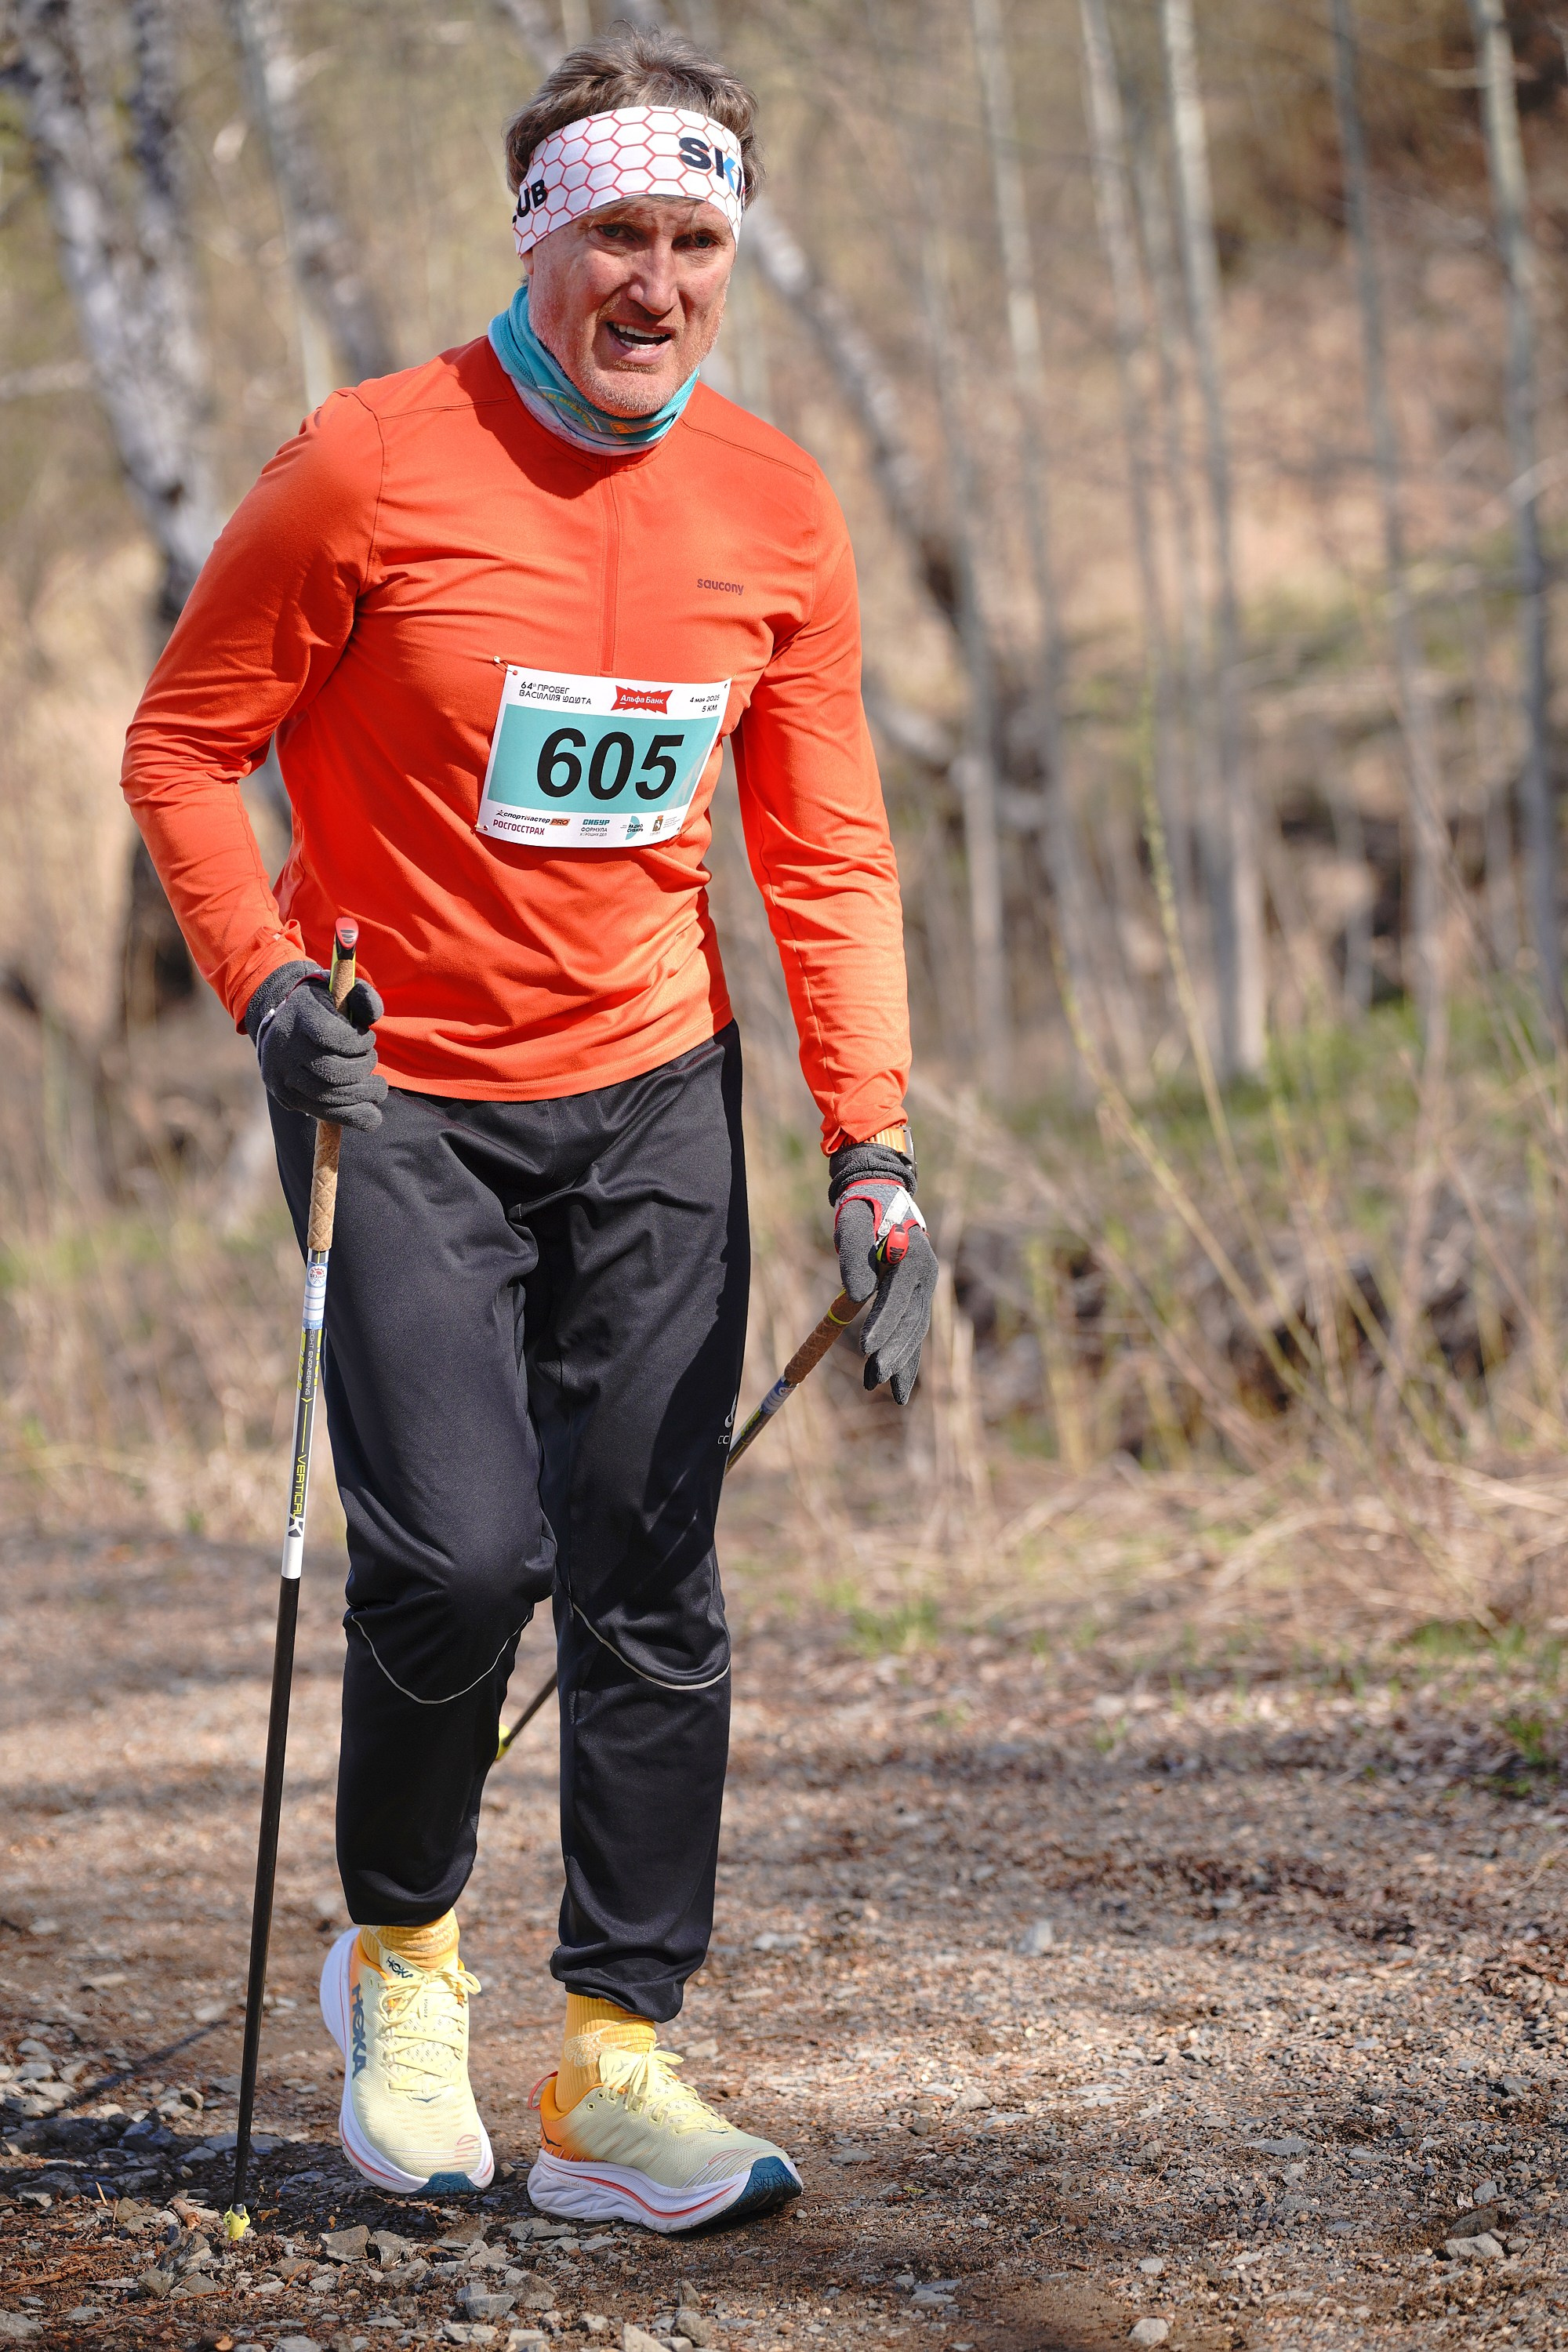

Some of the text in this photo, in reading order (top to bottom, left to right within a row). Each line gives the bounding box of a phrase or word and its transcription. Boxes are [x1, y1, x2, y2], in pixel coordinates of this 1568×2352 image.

[697, 579, 744, 596] saucony
[518, 689, 561, 702] ВАСИЛИЯ
[537, 684, 571, 695] ПРОБЕГ
[619, 694, 644, 705] Альфа
[536, 728, 685, 800] 605
[492, 819, 546, 836] РОСГОССТРАХ
[305, 1351, 314, 1396] ENGINEERING
[352, 1983, 366, 2080] HOKA
